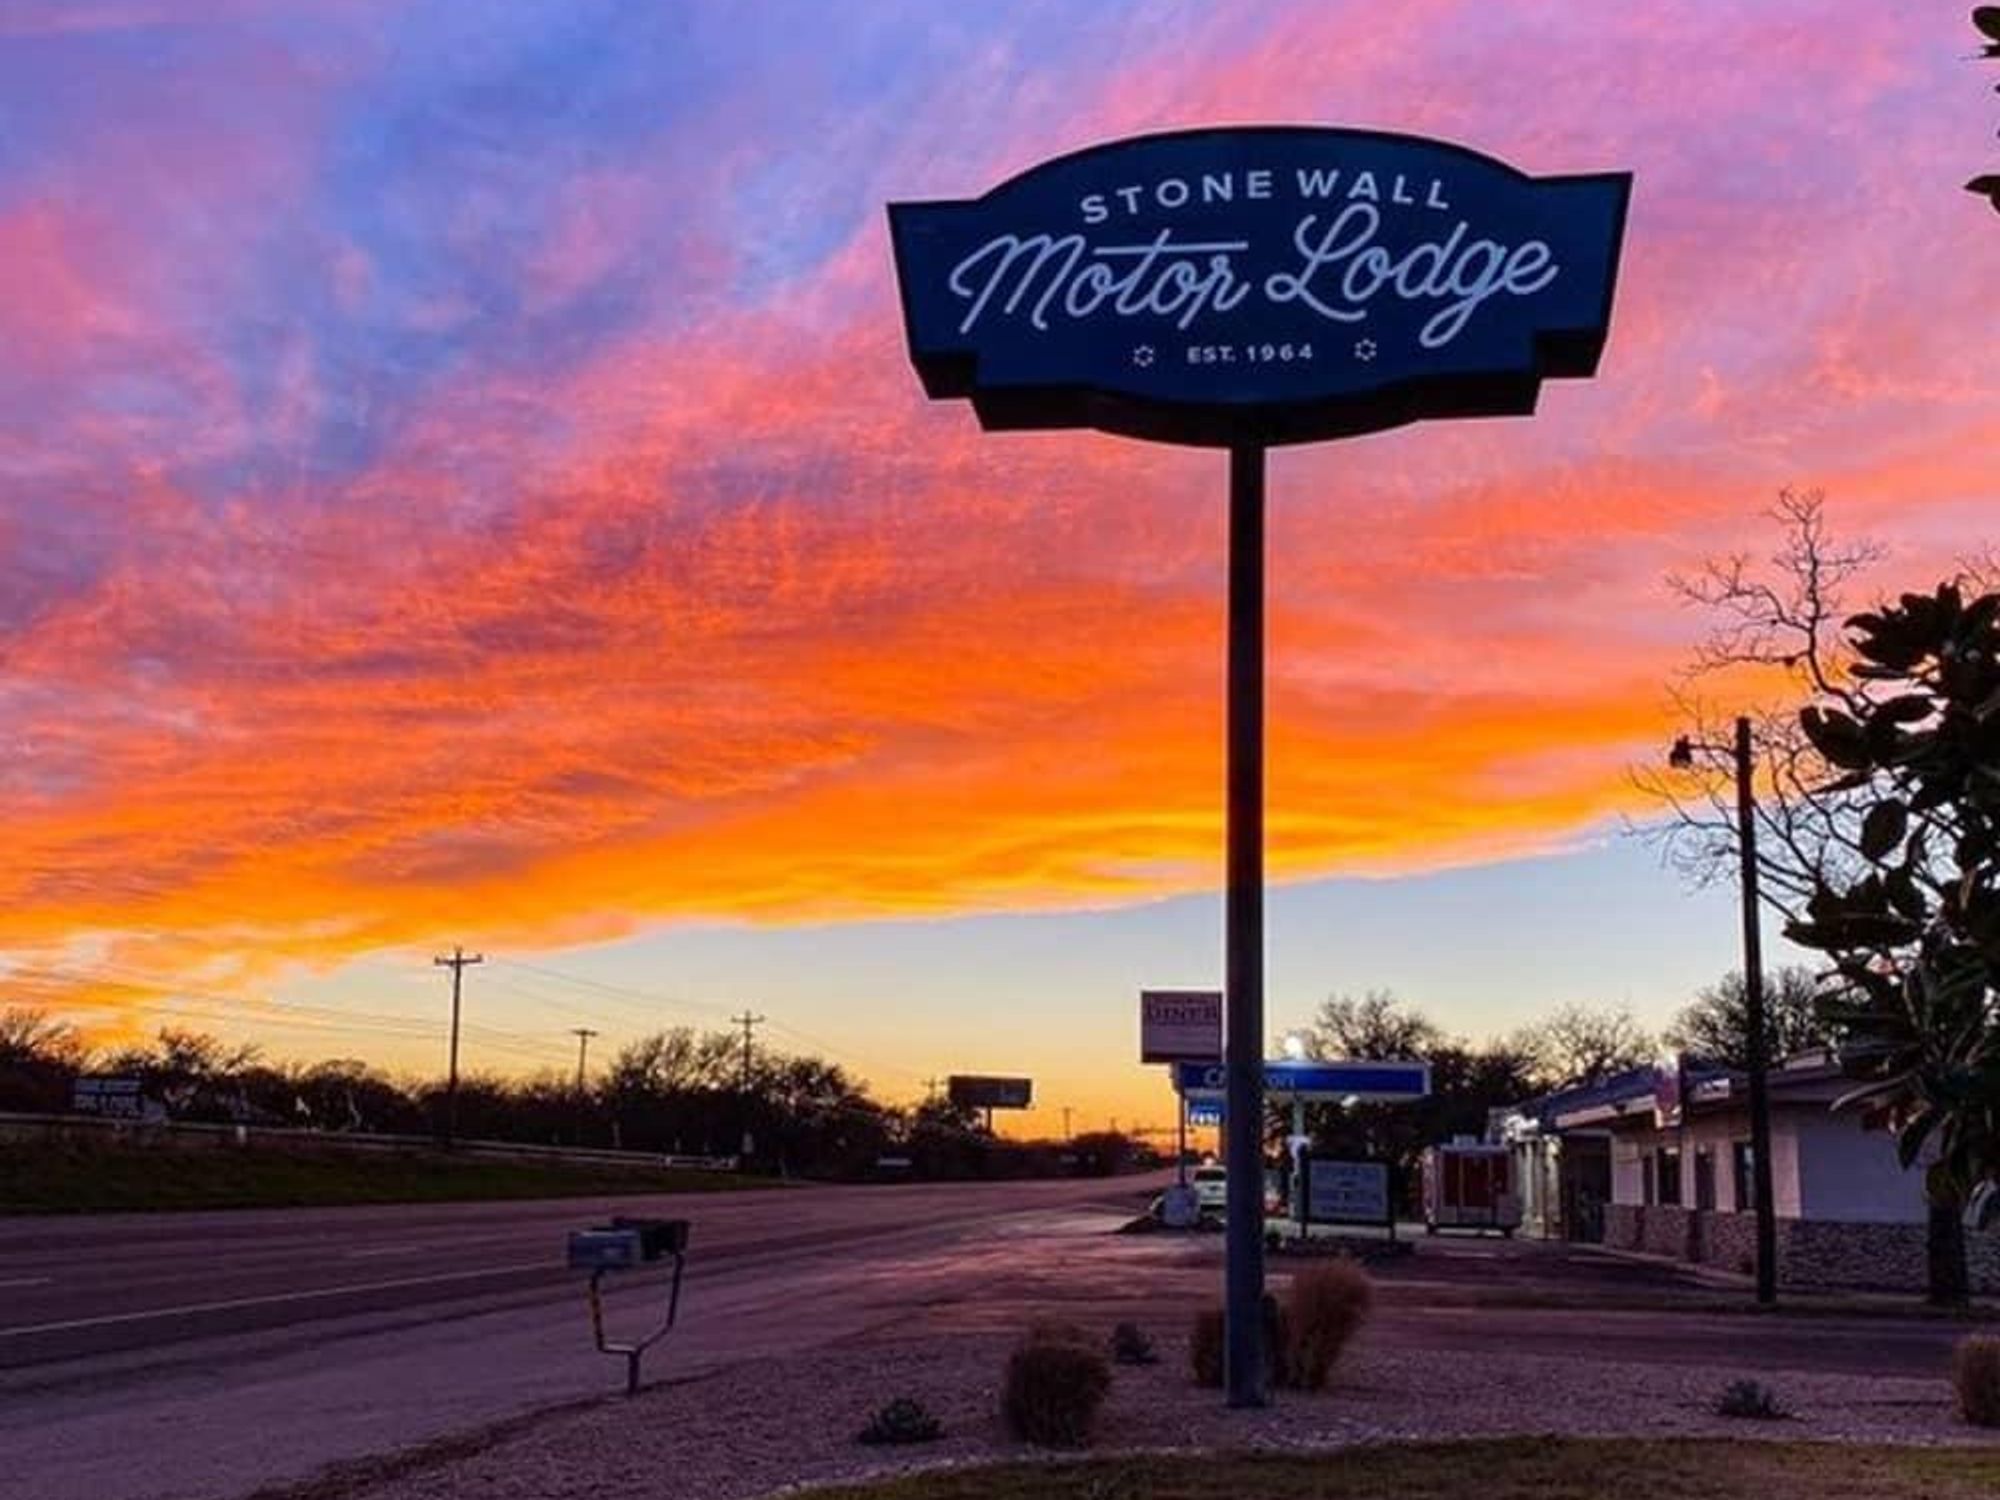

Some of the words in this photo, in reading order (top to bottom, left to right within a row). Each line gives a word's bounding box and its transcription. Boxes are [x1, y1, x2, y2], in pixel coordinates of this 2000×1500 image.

[1081, 170, 1272, 223] STONE
[1297, 169, 1450, 209] WALL
[949, 228, 1250, 334] Motor
[1265, 202, 1559, 348] Lodge
[1187, 346, 1237, 363] EST.
[1246, 344, 1313, 361] 1964
